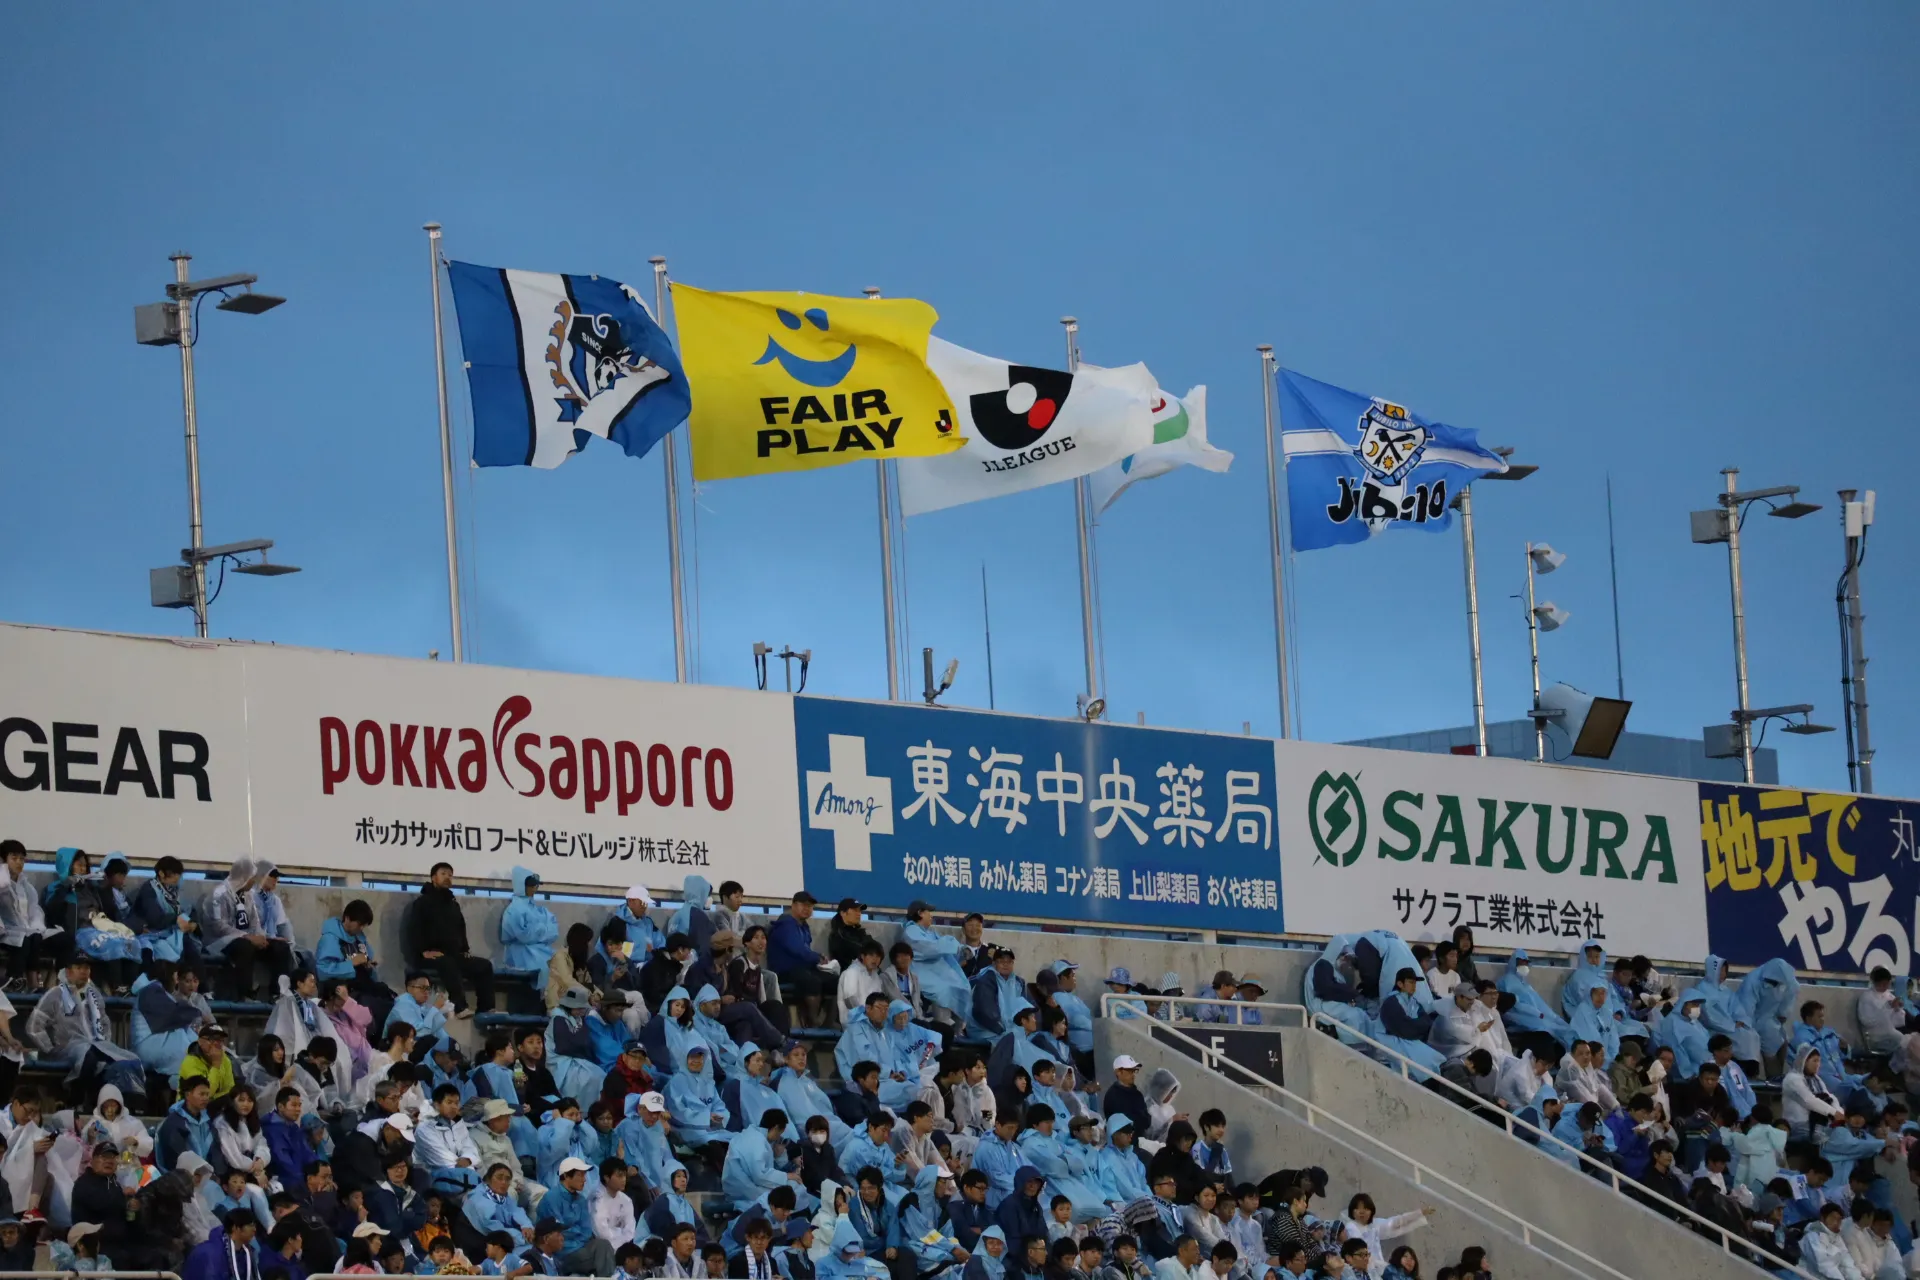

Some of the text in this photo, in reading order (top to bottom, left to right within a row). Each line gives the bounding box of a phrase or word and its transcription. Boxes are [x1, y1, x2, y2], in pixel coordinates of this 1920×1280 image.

[760, 389, 892, 425] FAIR
[757, 416, 904, 458] PLAY
[981, 435, 1077, 473] J.LEAGUE
[0, 717, 212, 802] GEAR
[815, 782, 884, 826] Among
[901, 739, 1273, 850] 東海中央薬局
[1378, 789, 1679, 884] SAKURA
[1701, 789, 1862, 893] 地元で
[903, 852, 1278, 911] なのか薬局 みかん薬局 コナン薬局 上山梨薬局 おくやま薬局
[1392, 887, 1606, 940] サクラ工業株式会社
[1778, 873, 1920, 977] やる
[1211, 1036, 1225, 1068] F
